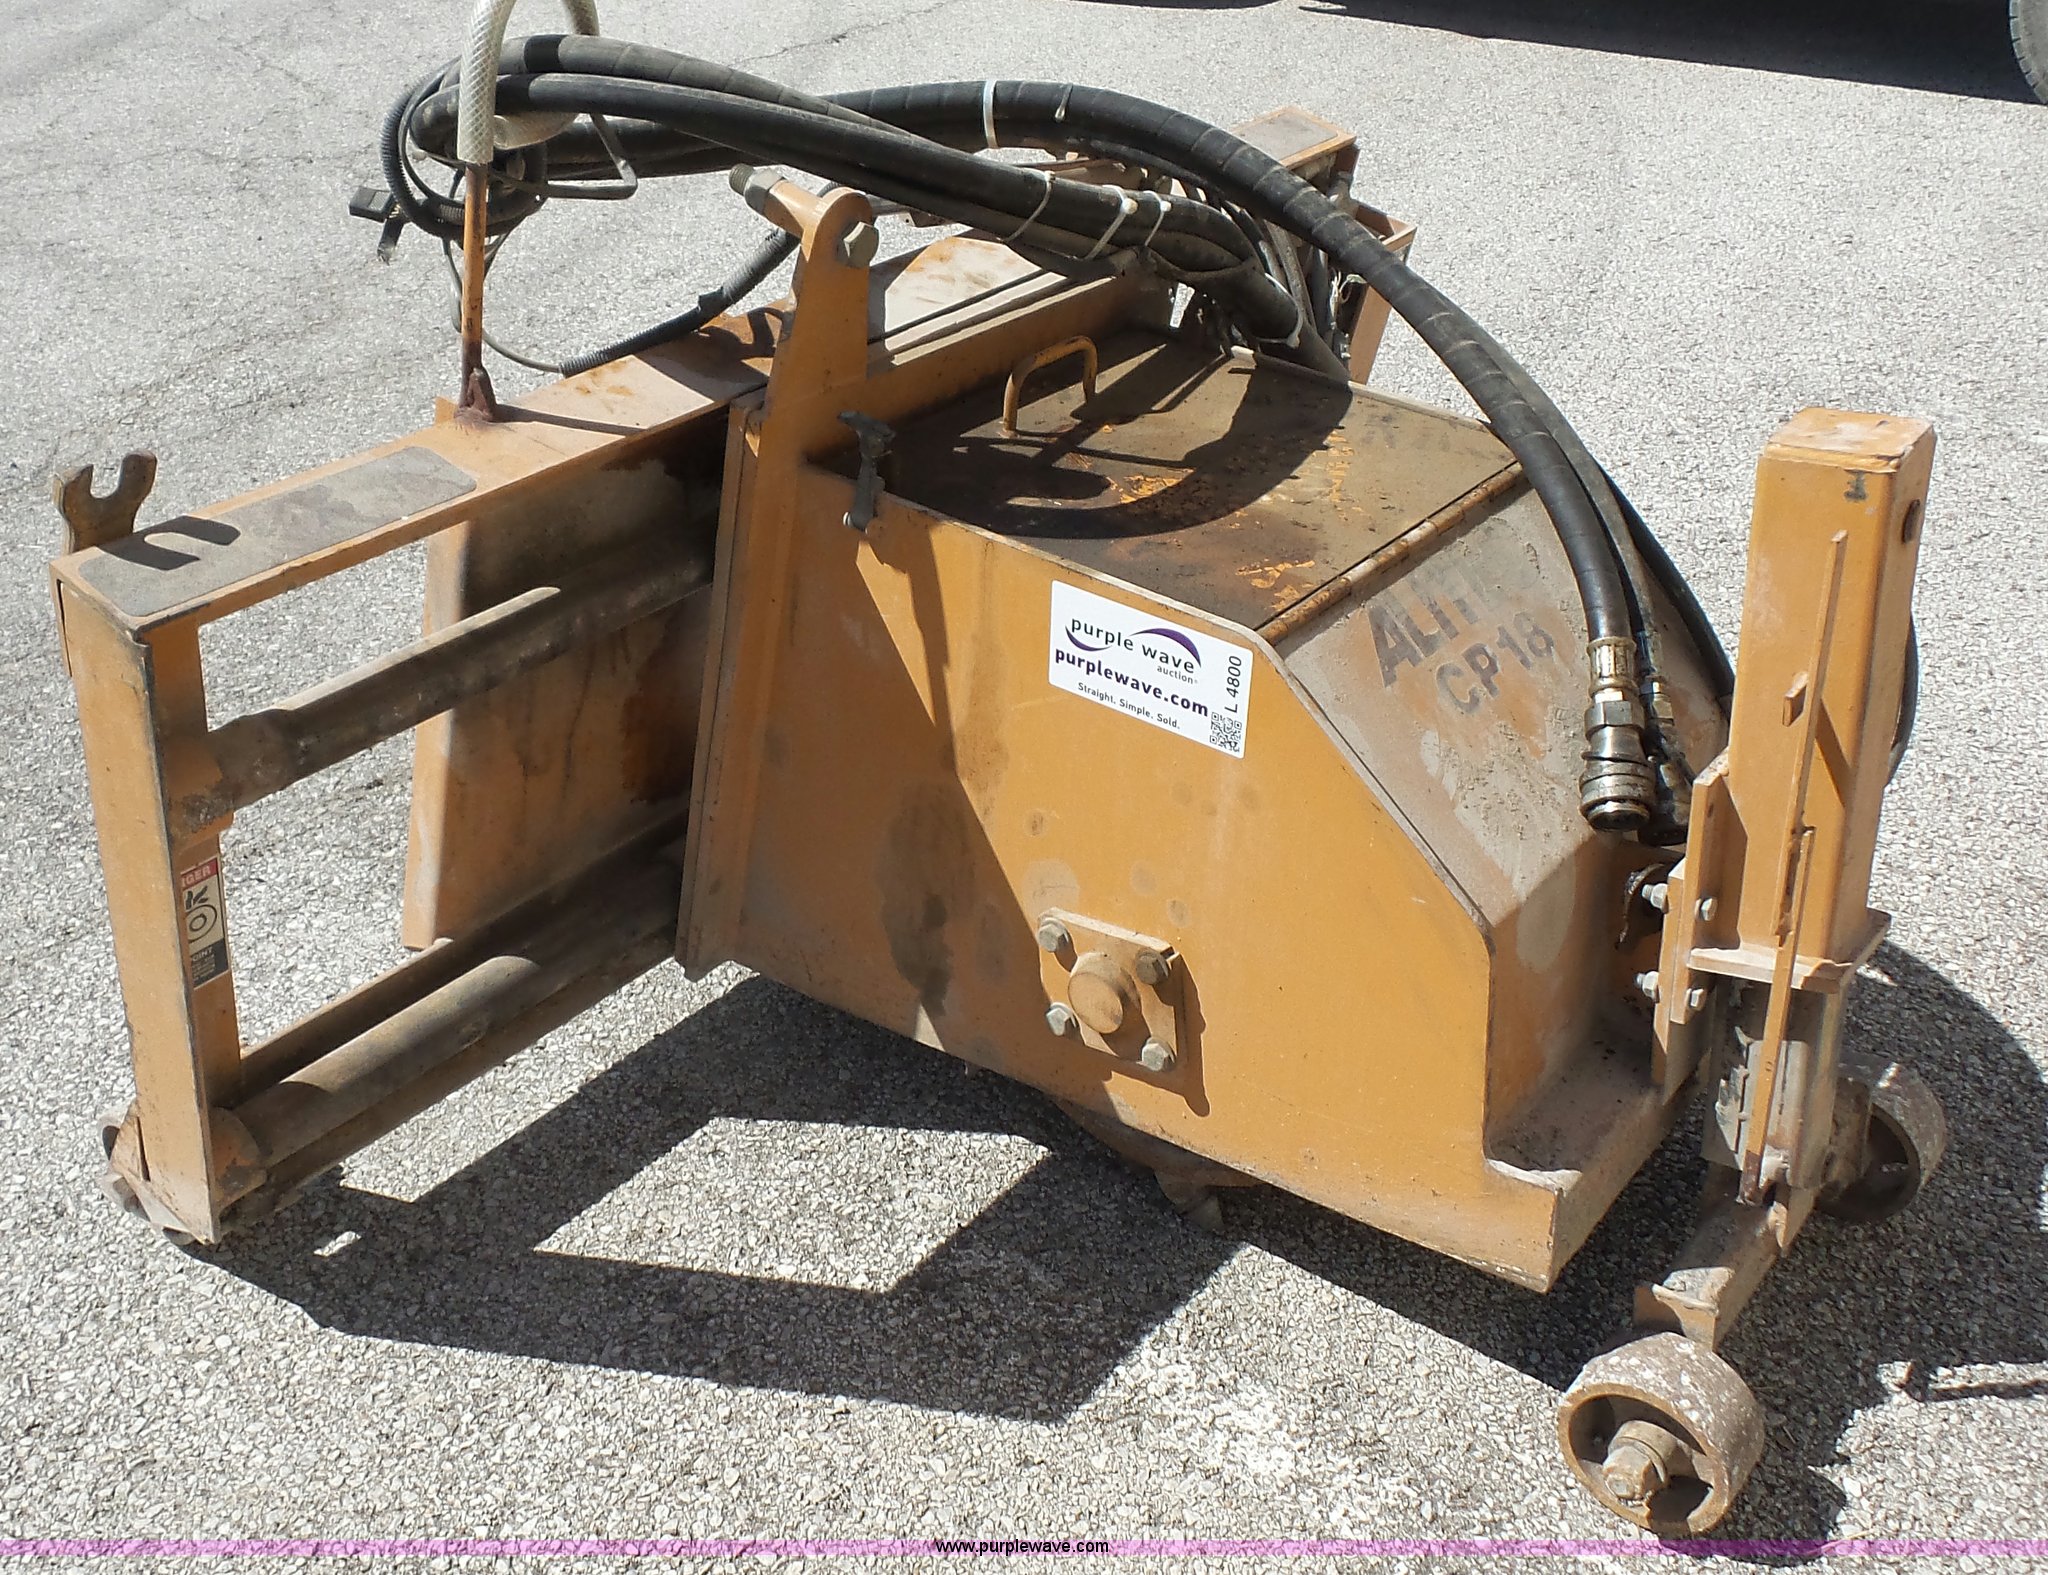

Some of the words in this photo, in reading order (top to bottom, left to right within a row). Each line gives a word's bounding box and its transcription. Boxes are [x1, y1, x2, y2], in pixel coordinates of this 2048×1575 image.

[1071, 618, 1134, 651] purple
[1142, 644, 1195, 674] wave
[1055, 648, 1209, 717] purplewave.com
[1157, 665, 1194, 685] auction
[1226, 655, 1242, 699] 4800
[1078, 682, 1117, 705] Straight.
[1119, 698, 1154, 719] Simple.
[1157, 713, 1181, 730] Sold.
[1225, 703, 1238, 713] L
